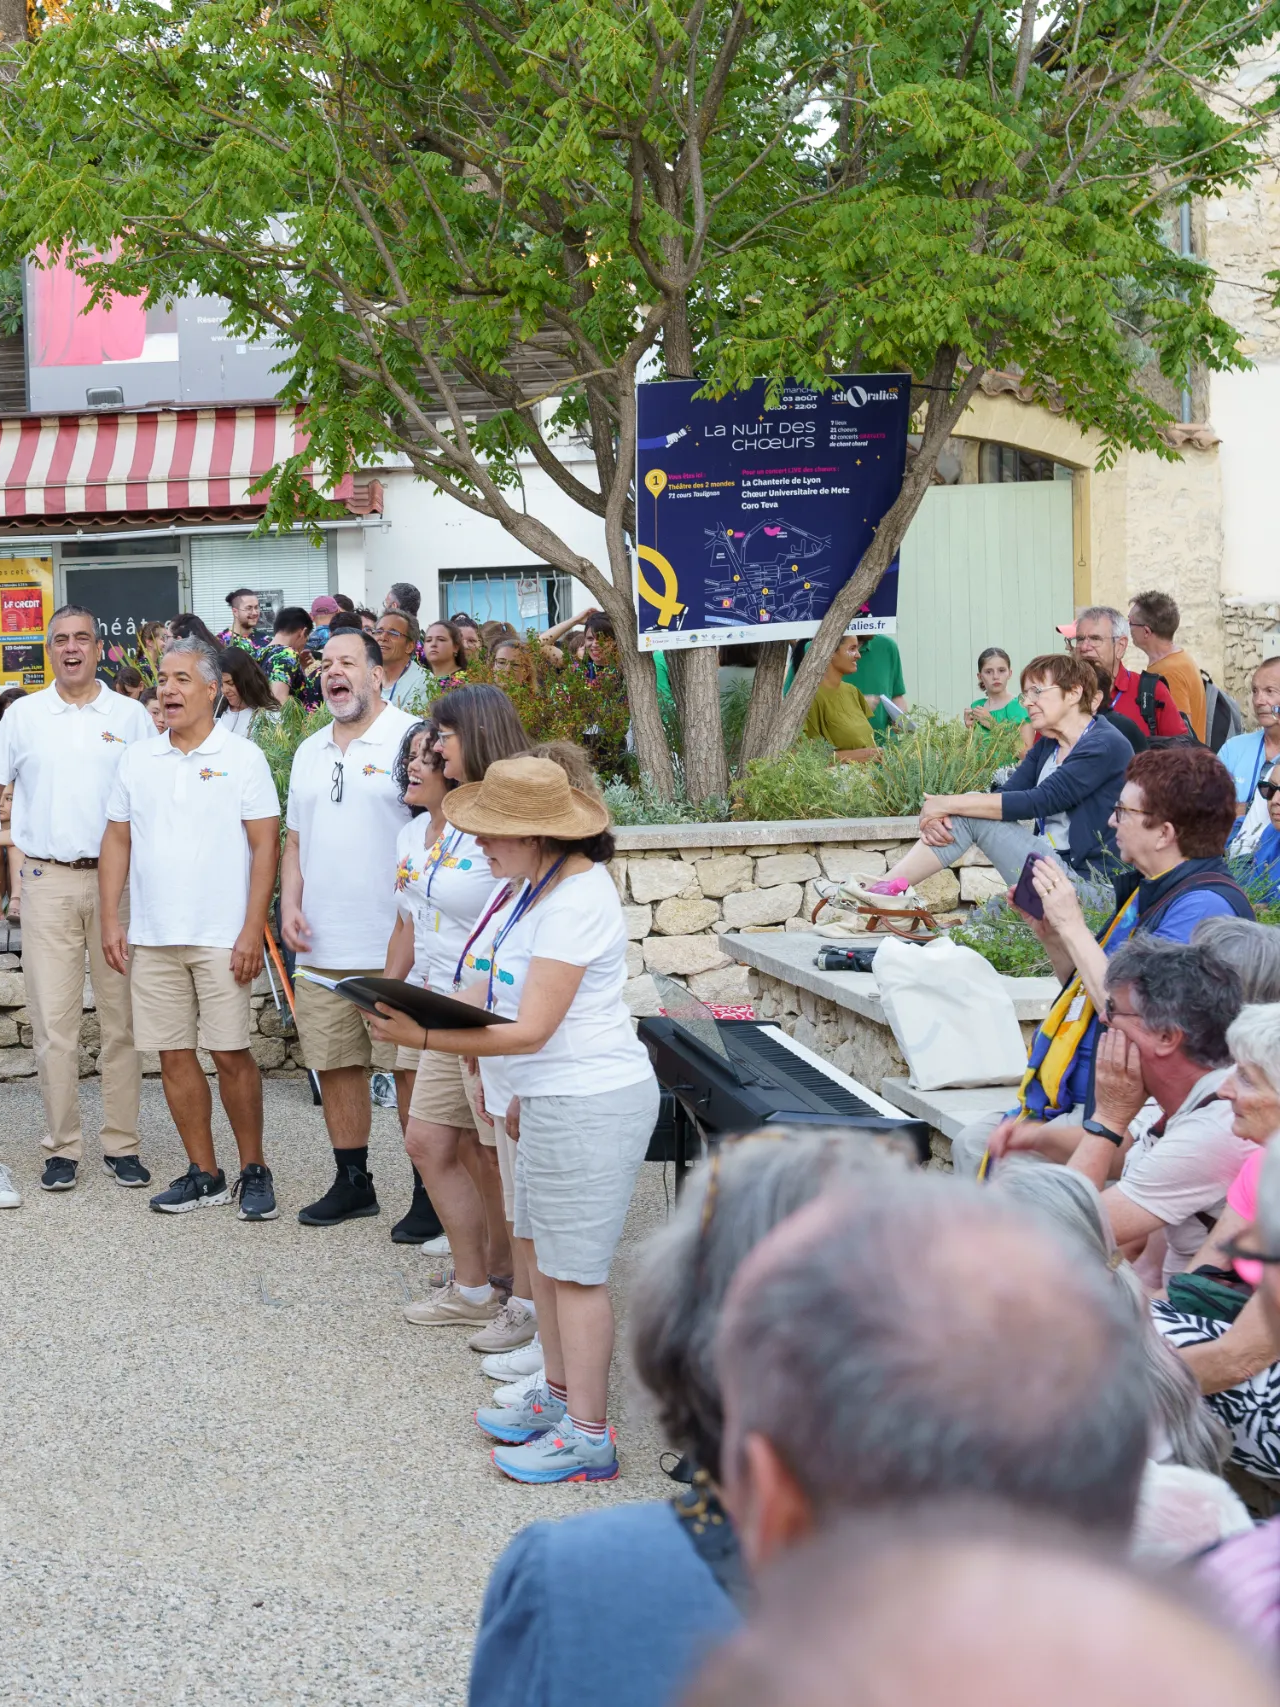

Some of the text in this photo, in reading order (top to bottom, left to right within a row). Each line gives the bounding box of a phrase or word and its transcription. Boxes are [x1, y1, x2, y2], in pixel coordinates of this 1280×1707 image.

[765, 467, 787, 475] concert
[711, 480, 735, 488] mondes
[741, 476, 821, 487] La Chanterie de Lyon
[741, 486, 850, 498] Chœur Universitaire de Metz
[741, 501, 778, 510] Coro Teva
